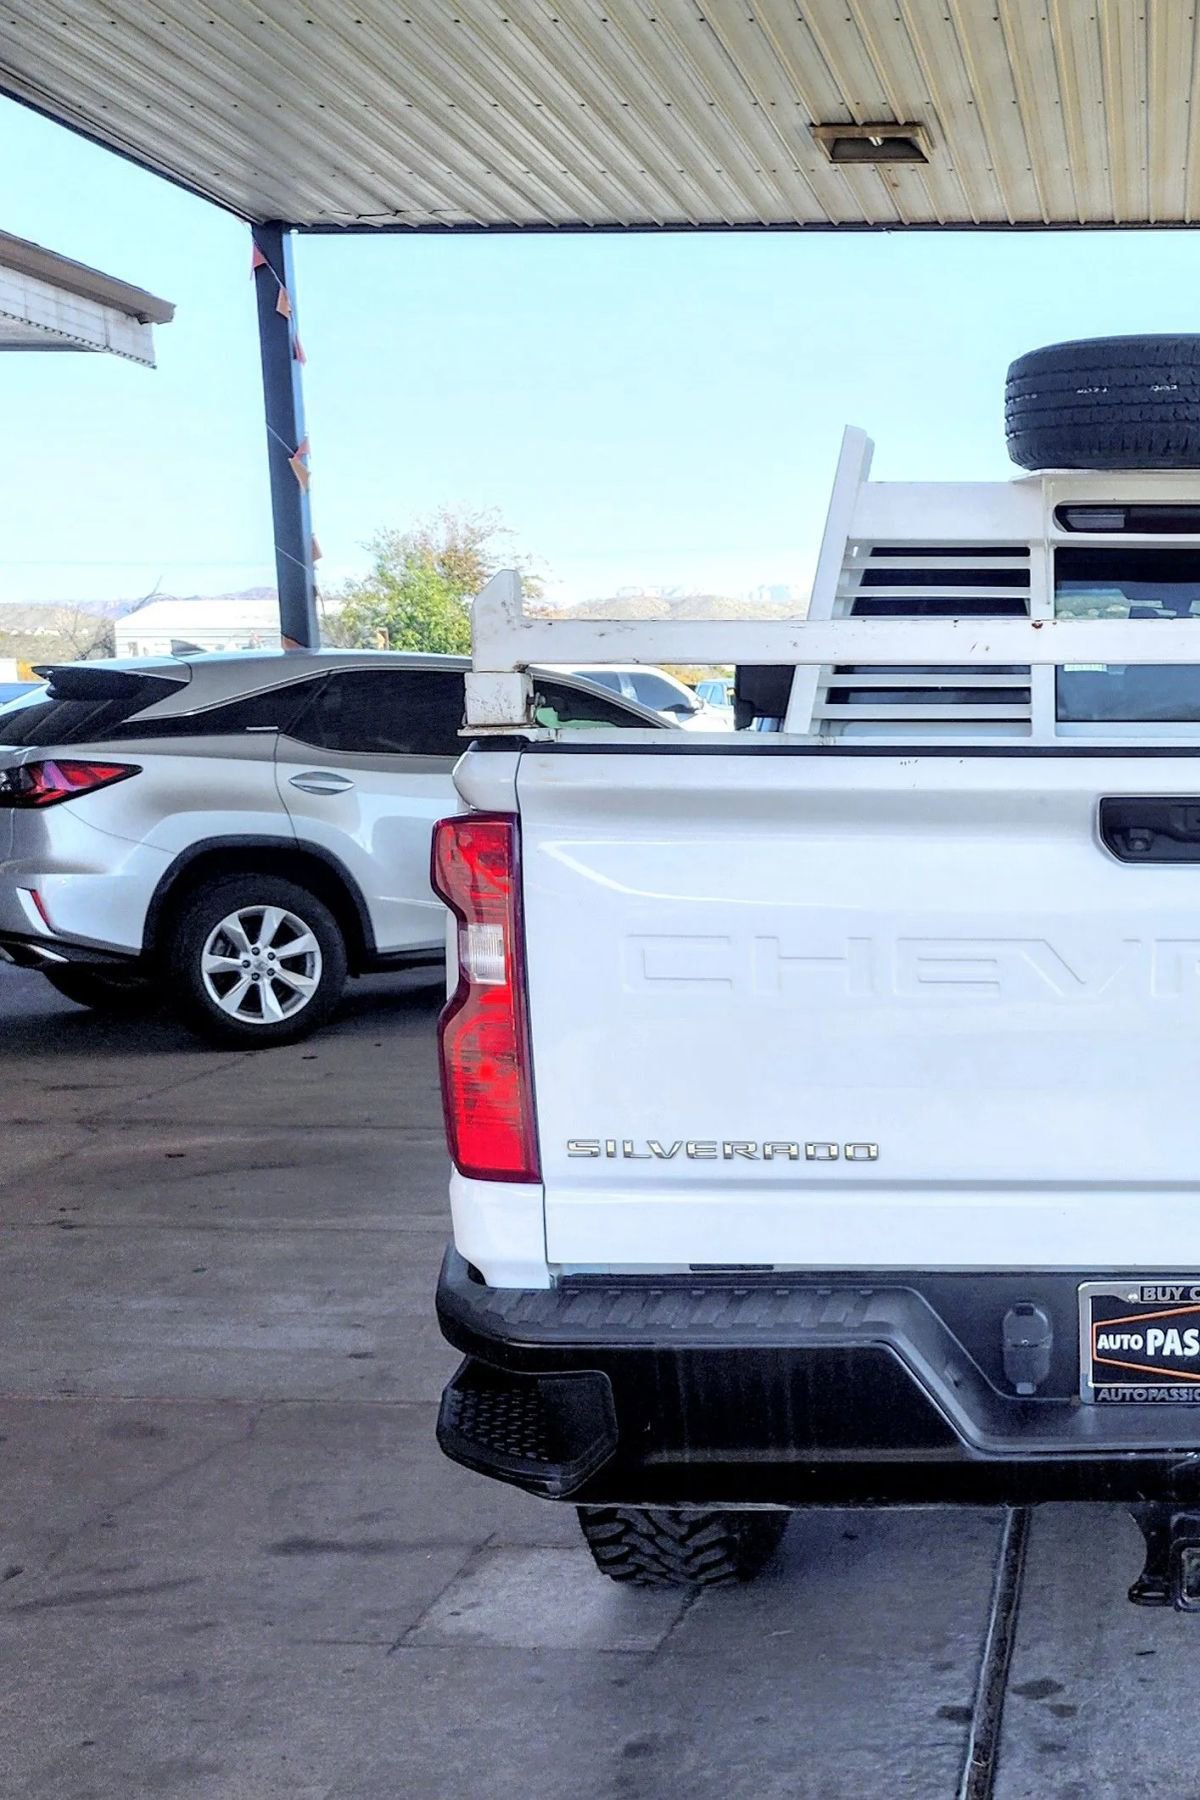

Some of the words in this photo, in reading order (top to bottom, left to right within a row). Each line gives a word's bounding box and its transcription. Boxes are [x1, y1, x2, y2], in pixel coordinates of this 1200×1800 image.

[567, 1138, 880, 1161] SILVERADO
[1142, 1286, 1184, 1301] BUY
[1097, 1333, 1143, 1350] AUTO
